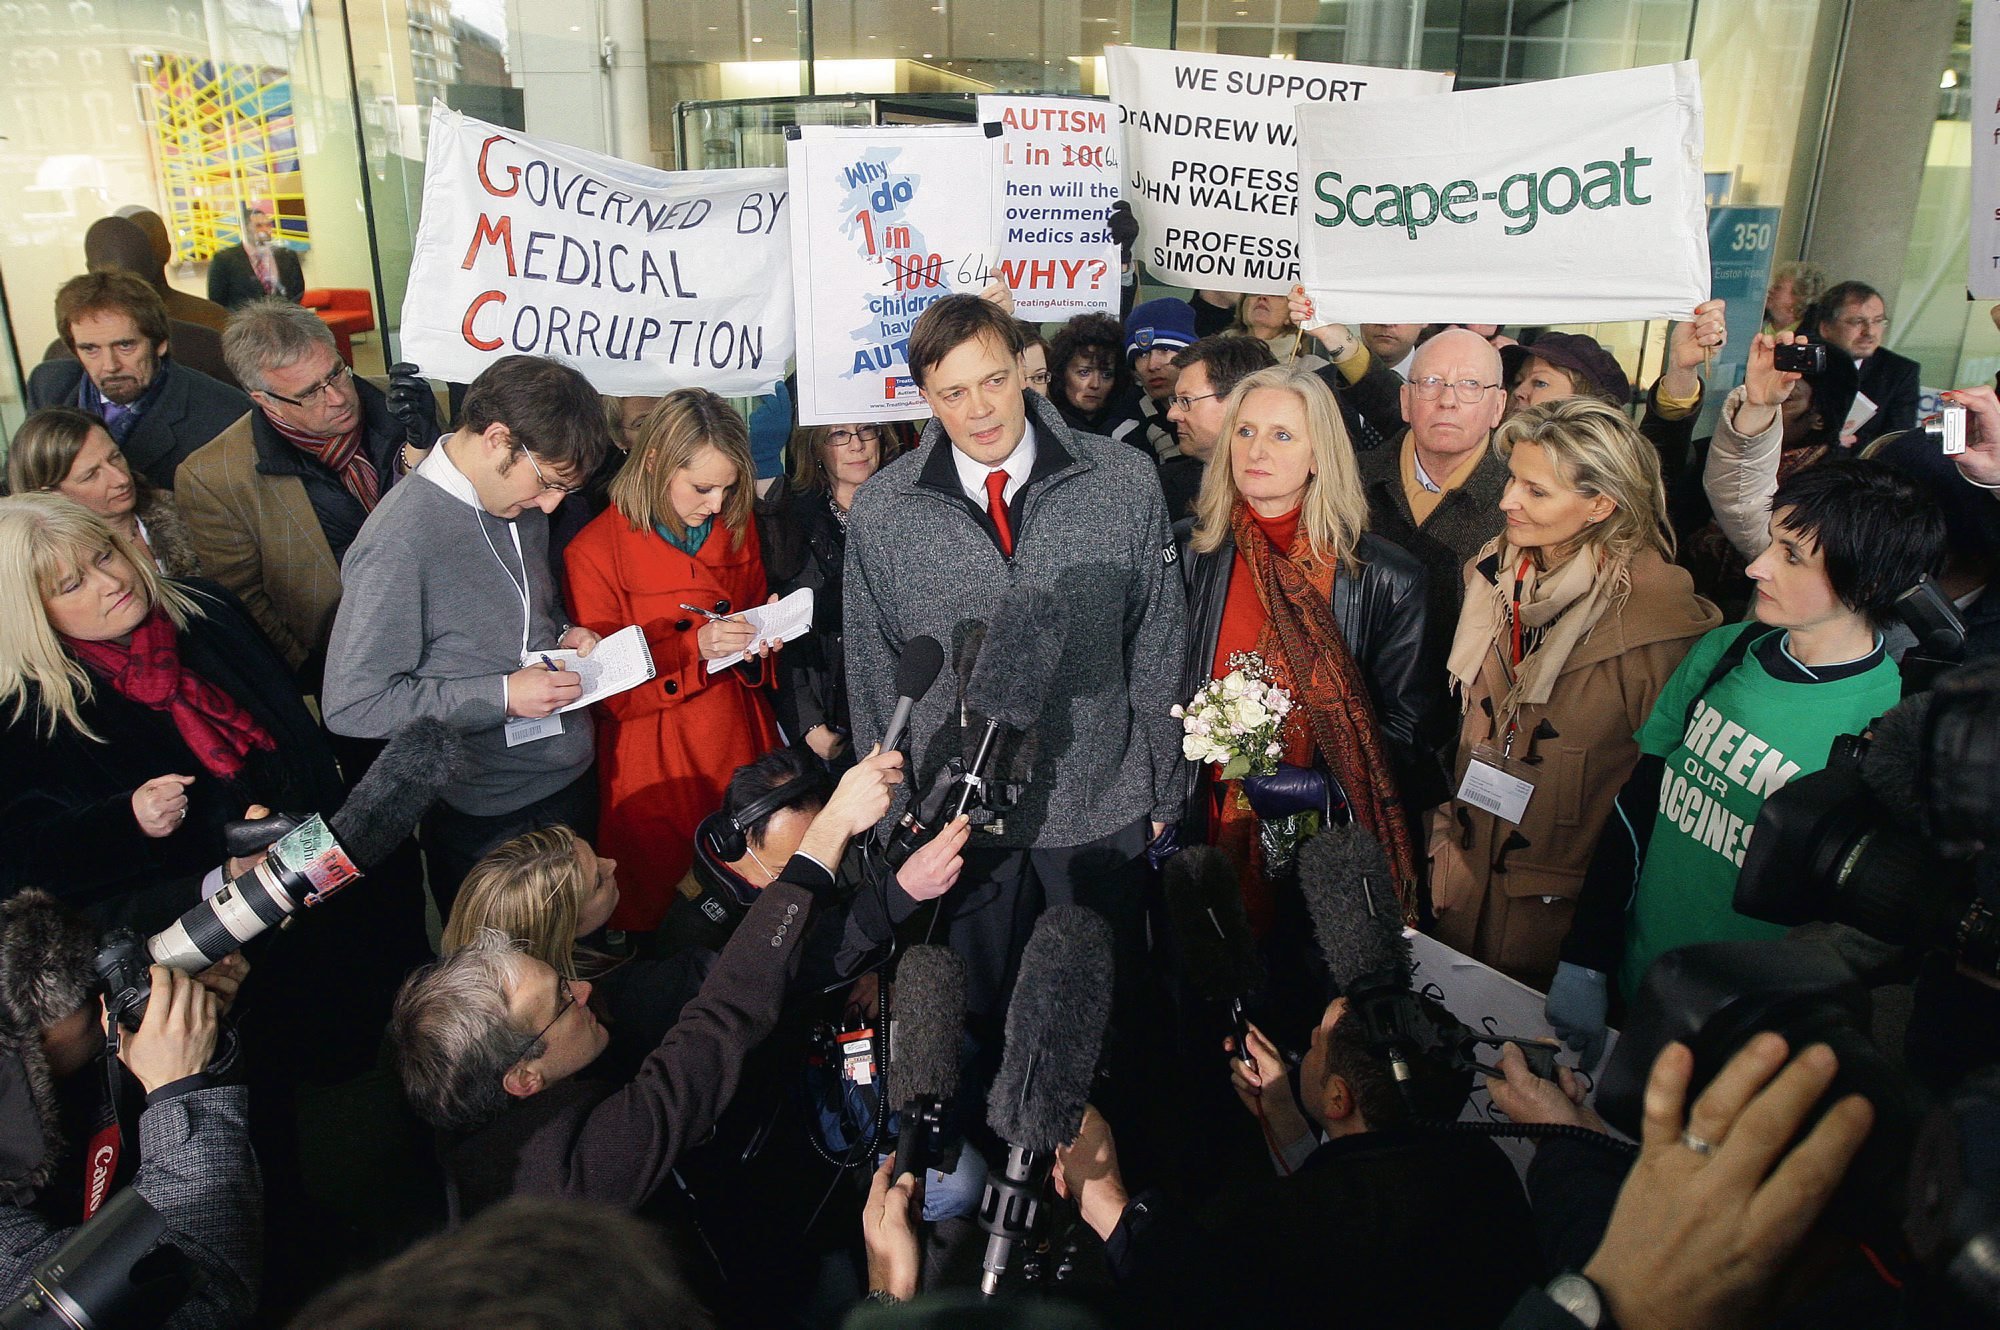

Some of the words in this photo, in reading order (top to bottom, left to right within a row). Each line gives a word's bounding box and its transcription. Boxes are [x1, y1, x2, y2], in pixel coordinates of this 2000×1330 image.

[1174, 66, 1219, 91] WE
[1226, 71, 1368, 102] SUPPORT
[1002, 107, 1106, 134] AUTISM
[1139, 110, 1259, 143] ANDREW
[1025, 142, 1050, 166] in
[844, 160, 888, 190] Why
[1006, 180, 1042, 197] hen
[1049, 181, 1084, 198] will
[1090, 182, 1119, 199] the
[871, 181, 914, 213] do
[1313, 146, 1653, 241] Scape-goat
[736, 191, 789, 236] BY
[1006, 206, 1113, 221] overnment
[855, 209, 876, 255] 1
[885, 226, 911, 249] in
[1008, 228, 1074, 243] Medics
[1080, 228, 1113, 243] ask
[1165, 227, 1300, 260] PROFESS
[1731, 223, 1772, 252] 350
[460, 212, 698, 299] MEDICAL
[891, 252, 942, 292] 100
[957, 252, 995, 288] 64
[1154, 246, 1236, 277] SIMON
[1000, 259, 1108, 290] WHY?
[869, 294, 940, 318] childre
[461, 290, 763, 370] CORRUPTION
[1683, 757, 1729, 798] OUR
[90, 1144, 114, 1219] Cano
